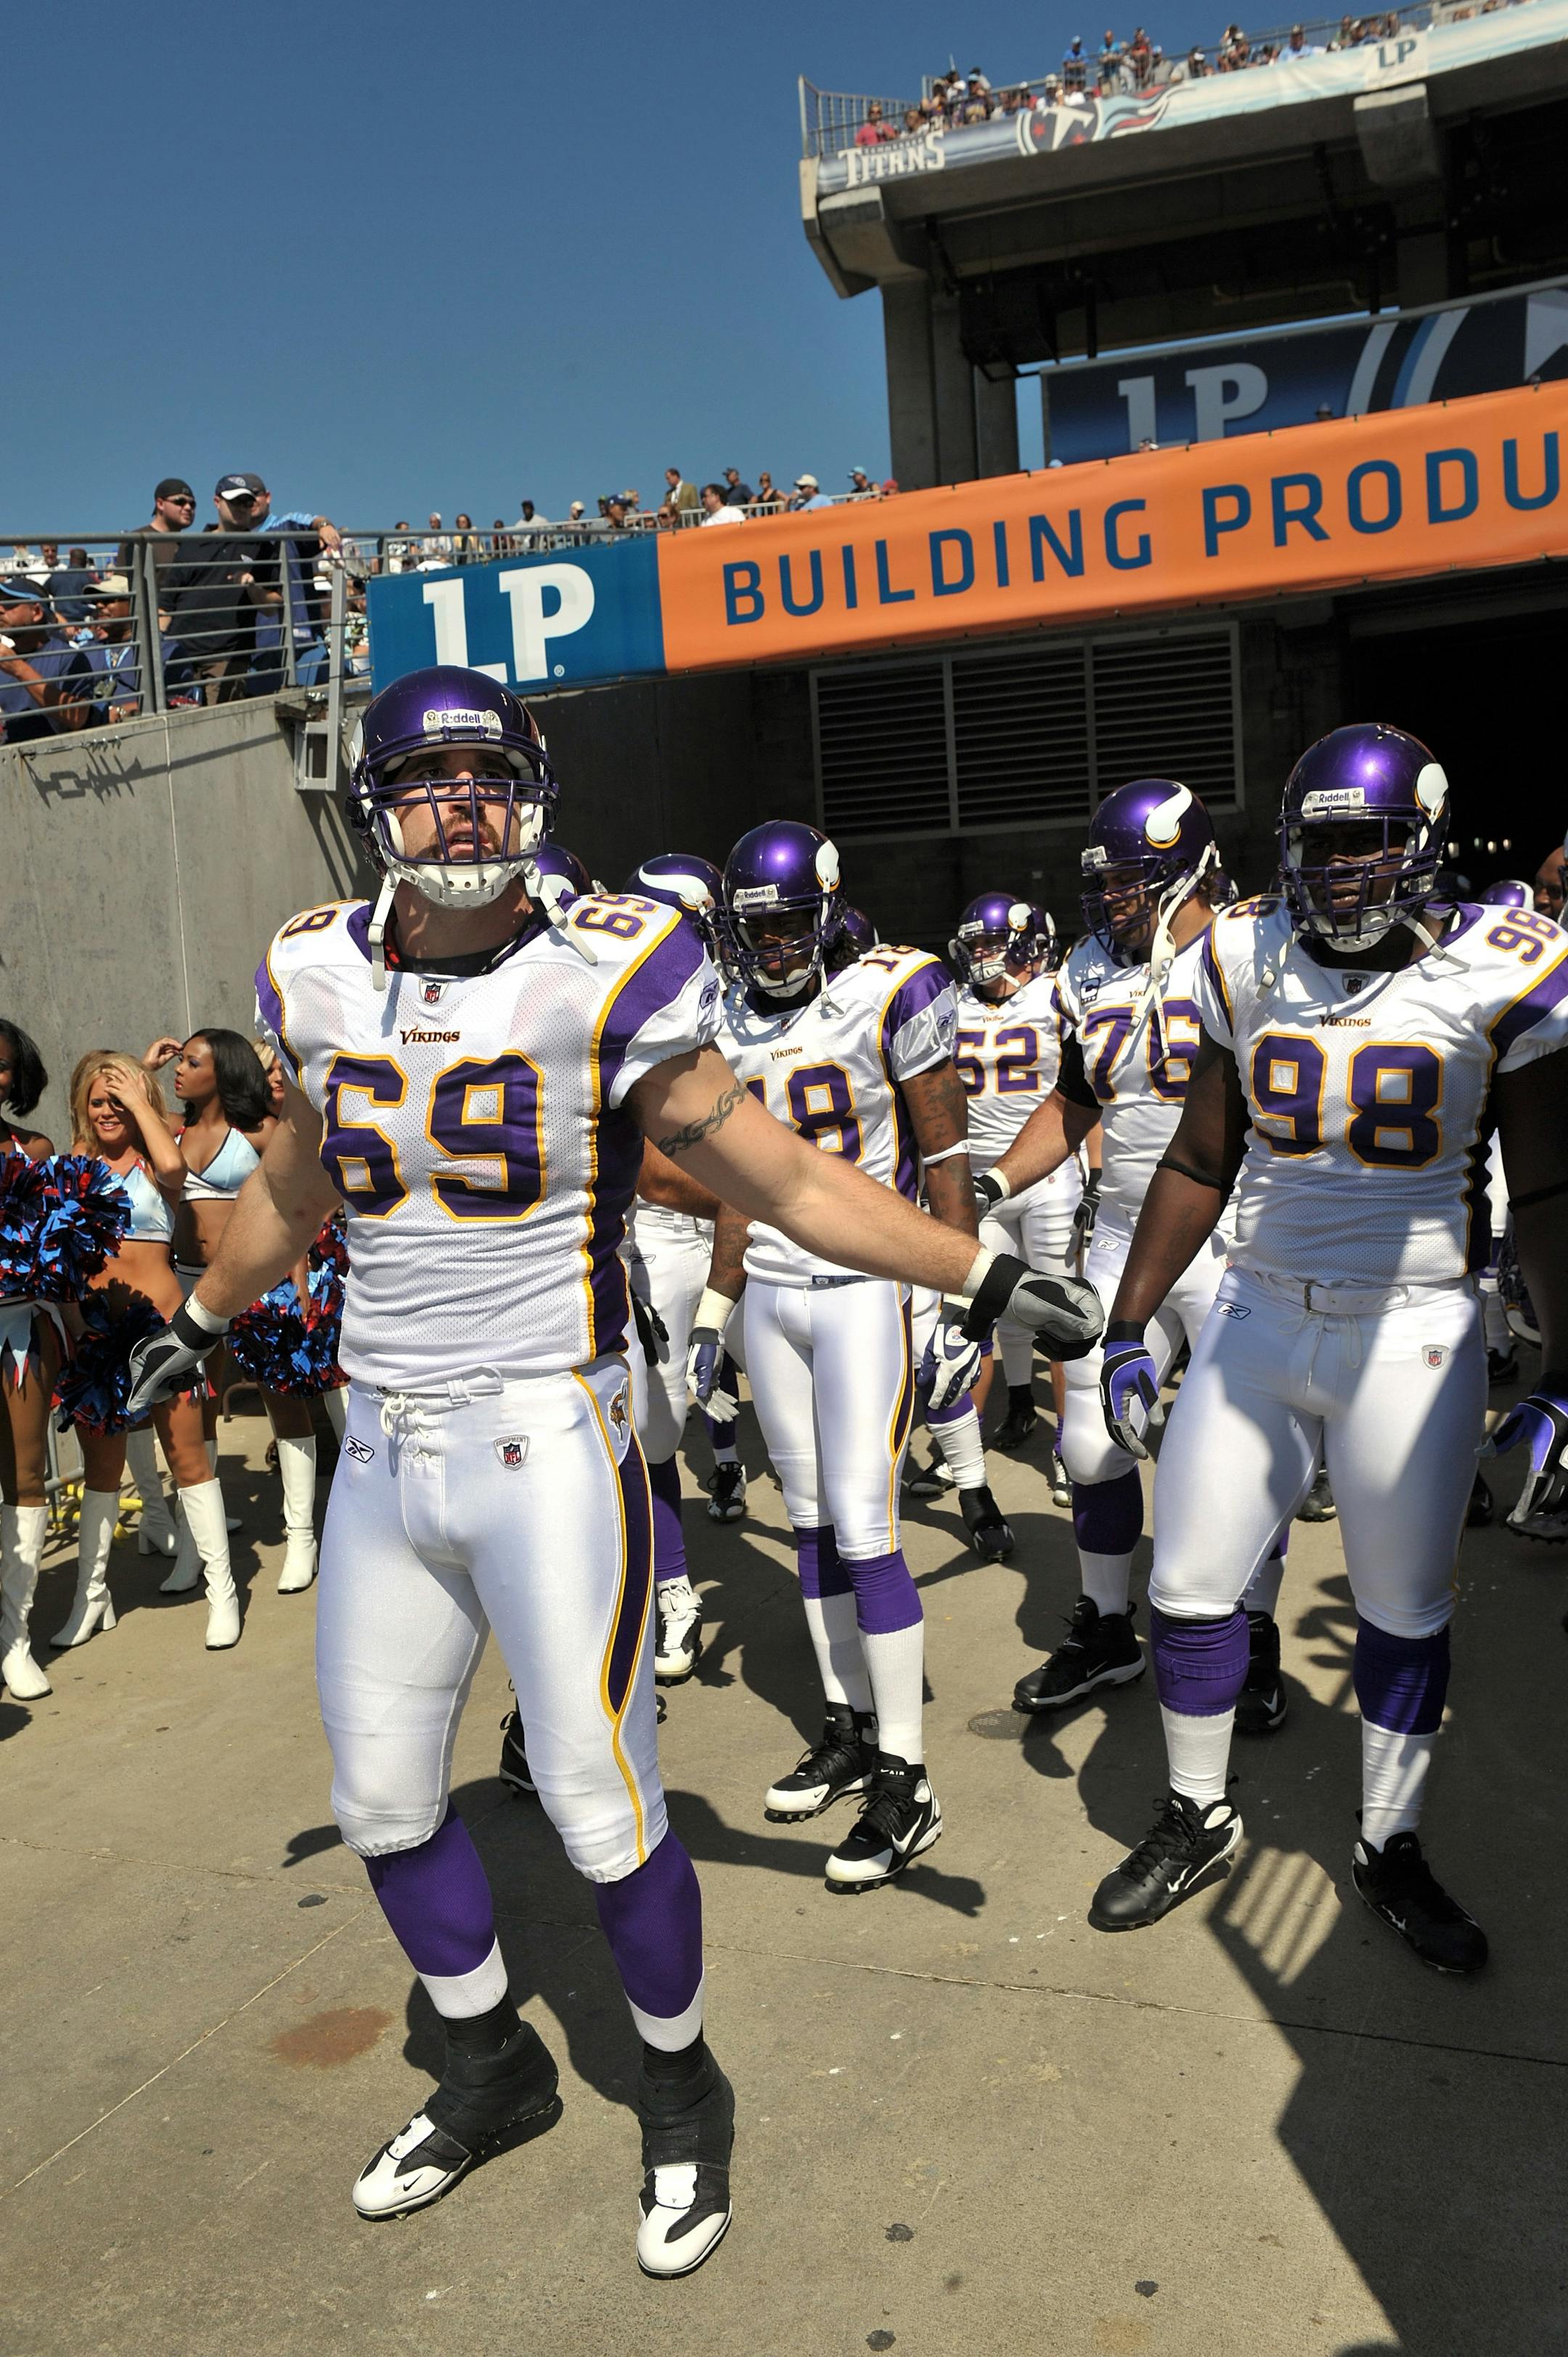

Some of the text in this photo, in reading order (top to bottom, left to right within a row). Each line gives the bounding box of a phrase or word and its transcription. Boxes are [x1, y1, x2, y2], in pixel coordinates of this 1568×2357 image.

[1376, 39, 1416, 68] LP
[838, 131, 944, 188] TITANS
[1118, 363, 1268, 452] LP
[723, 431, 1559, 625] BUILDING PRODU
[423, 563, 595, 683] LP
[1319, 792, 1349, 803] Riddell
[1485, 907, 1563, 965] 98
[952, 1024, 1041, 1099] 52
[1082, 997, 1201, 1102] 76
[319, 1050, 547, 1223] 69
[1251, 1032, 1444, 1171] 98
